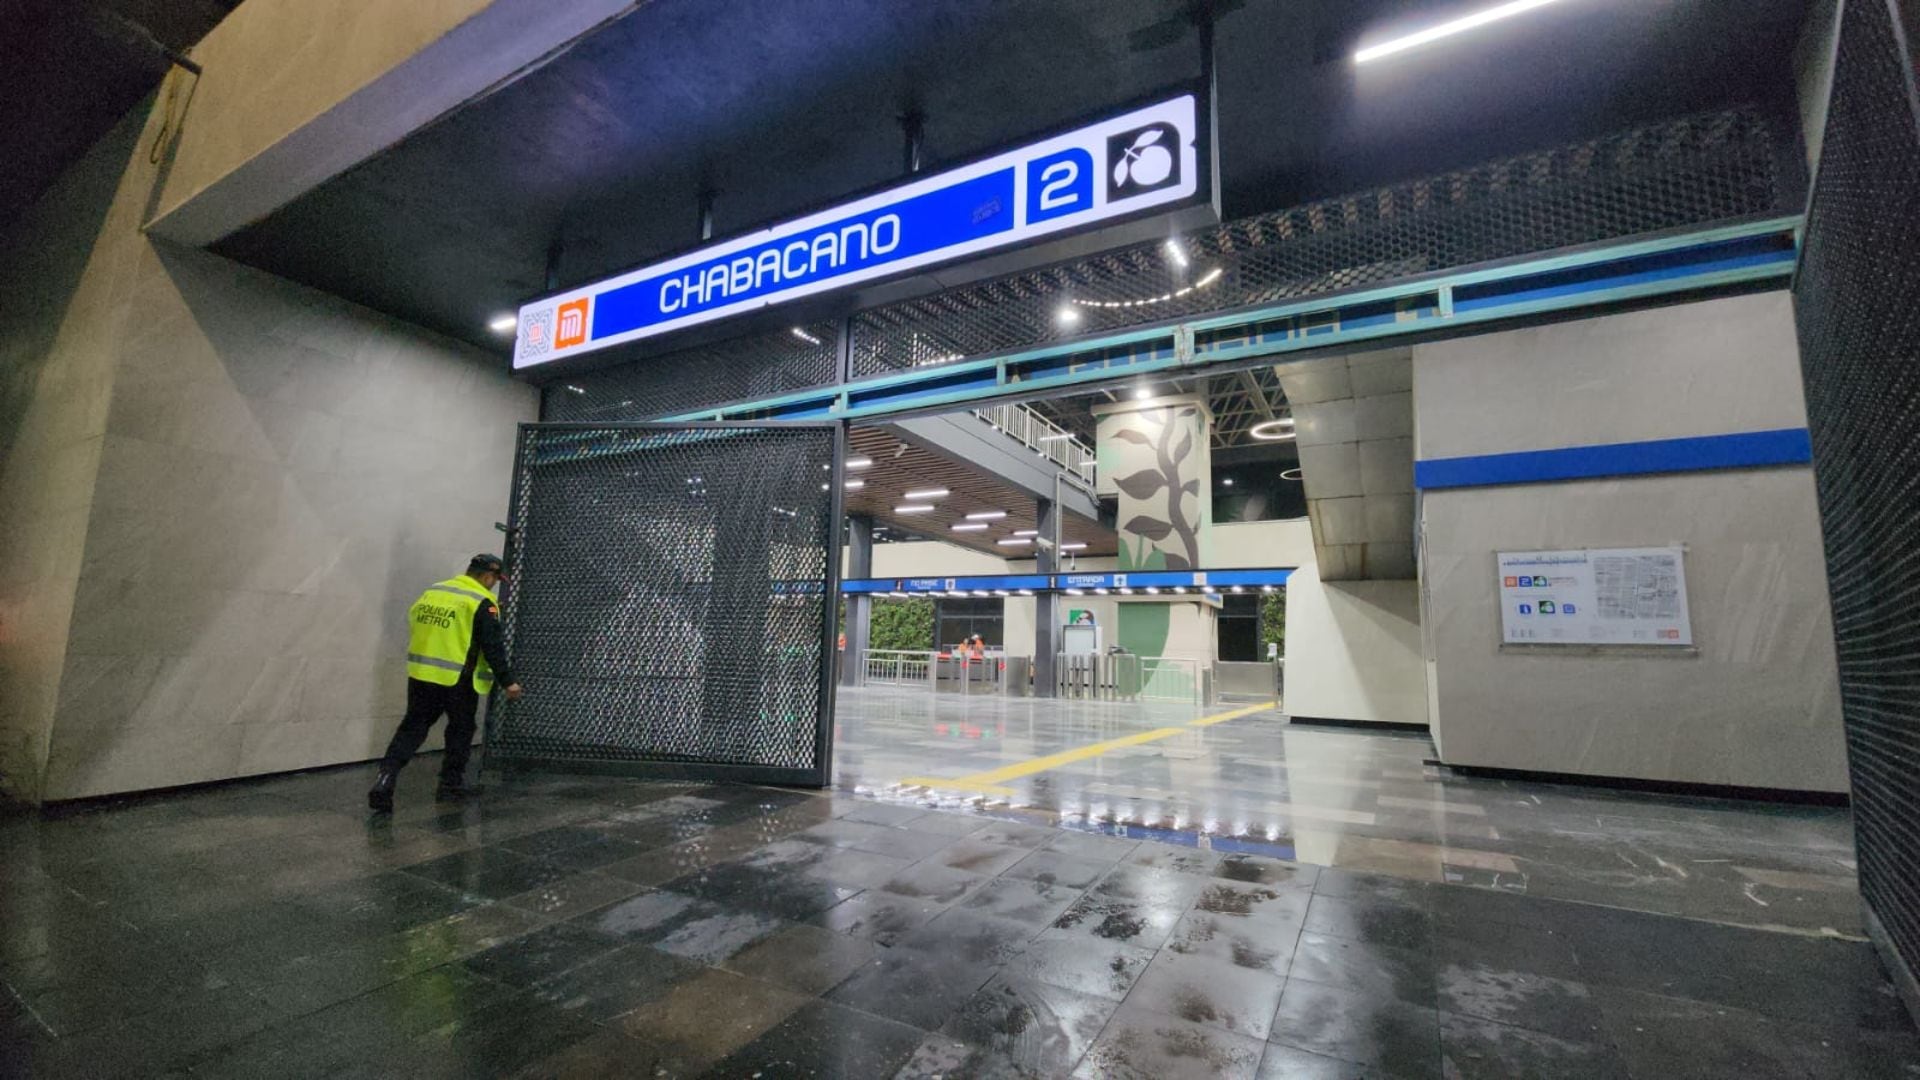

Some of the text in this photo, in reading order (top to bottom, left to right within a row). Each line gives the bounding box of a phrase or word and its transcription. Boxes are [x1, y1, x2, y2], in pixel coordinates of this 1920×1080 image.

[660, 213, 901, 314] CHABACANO
[1040, 160, 1080, 210] 2
[417, 614, 450, 629] METRO
